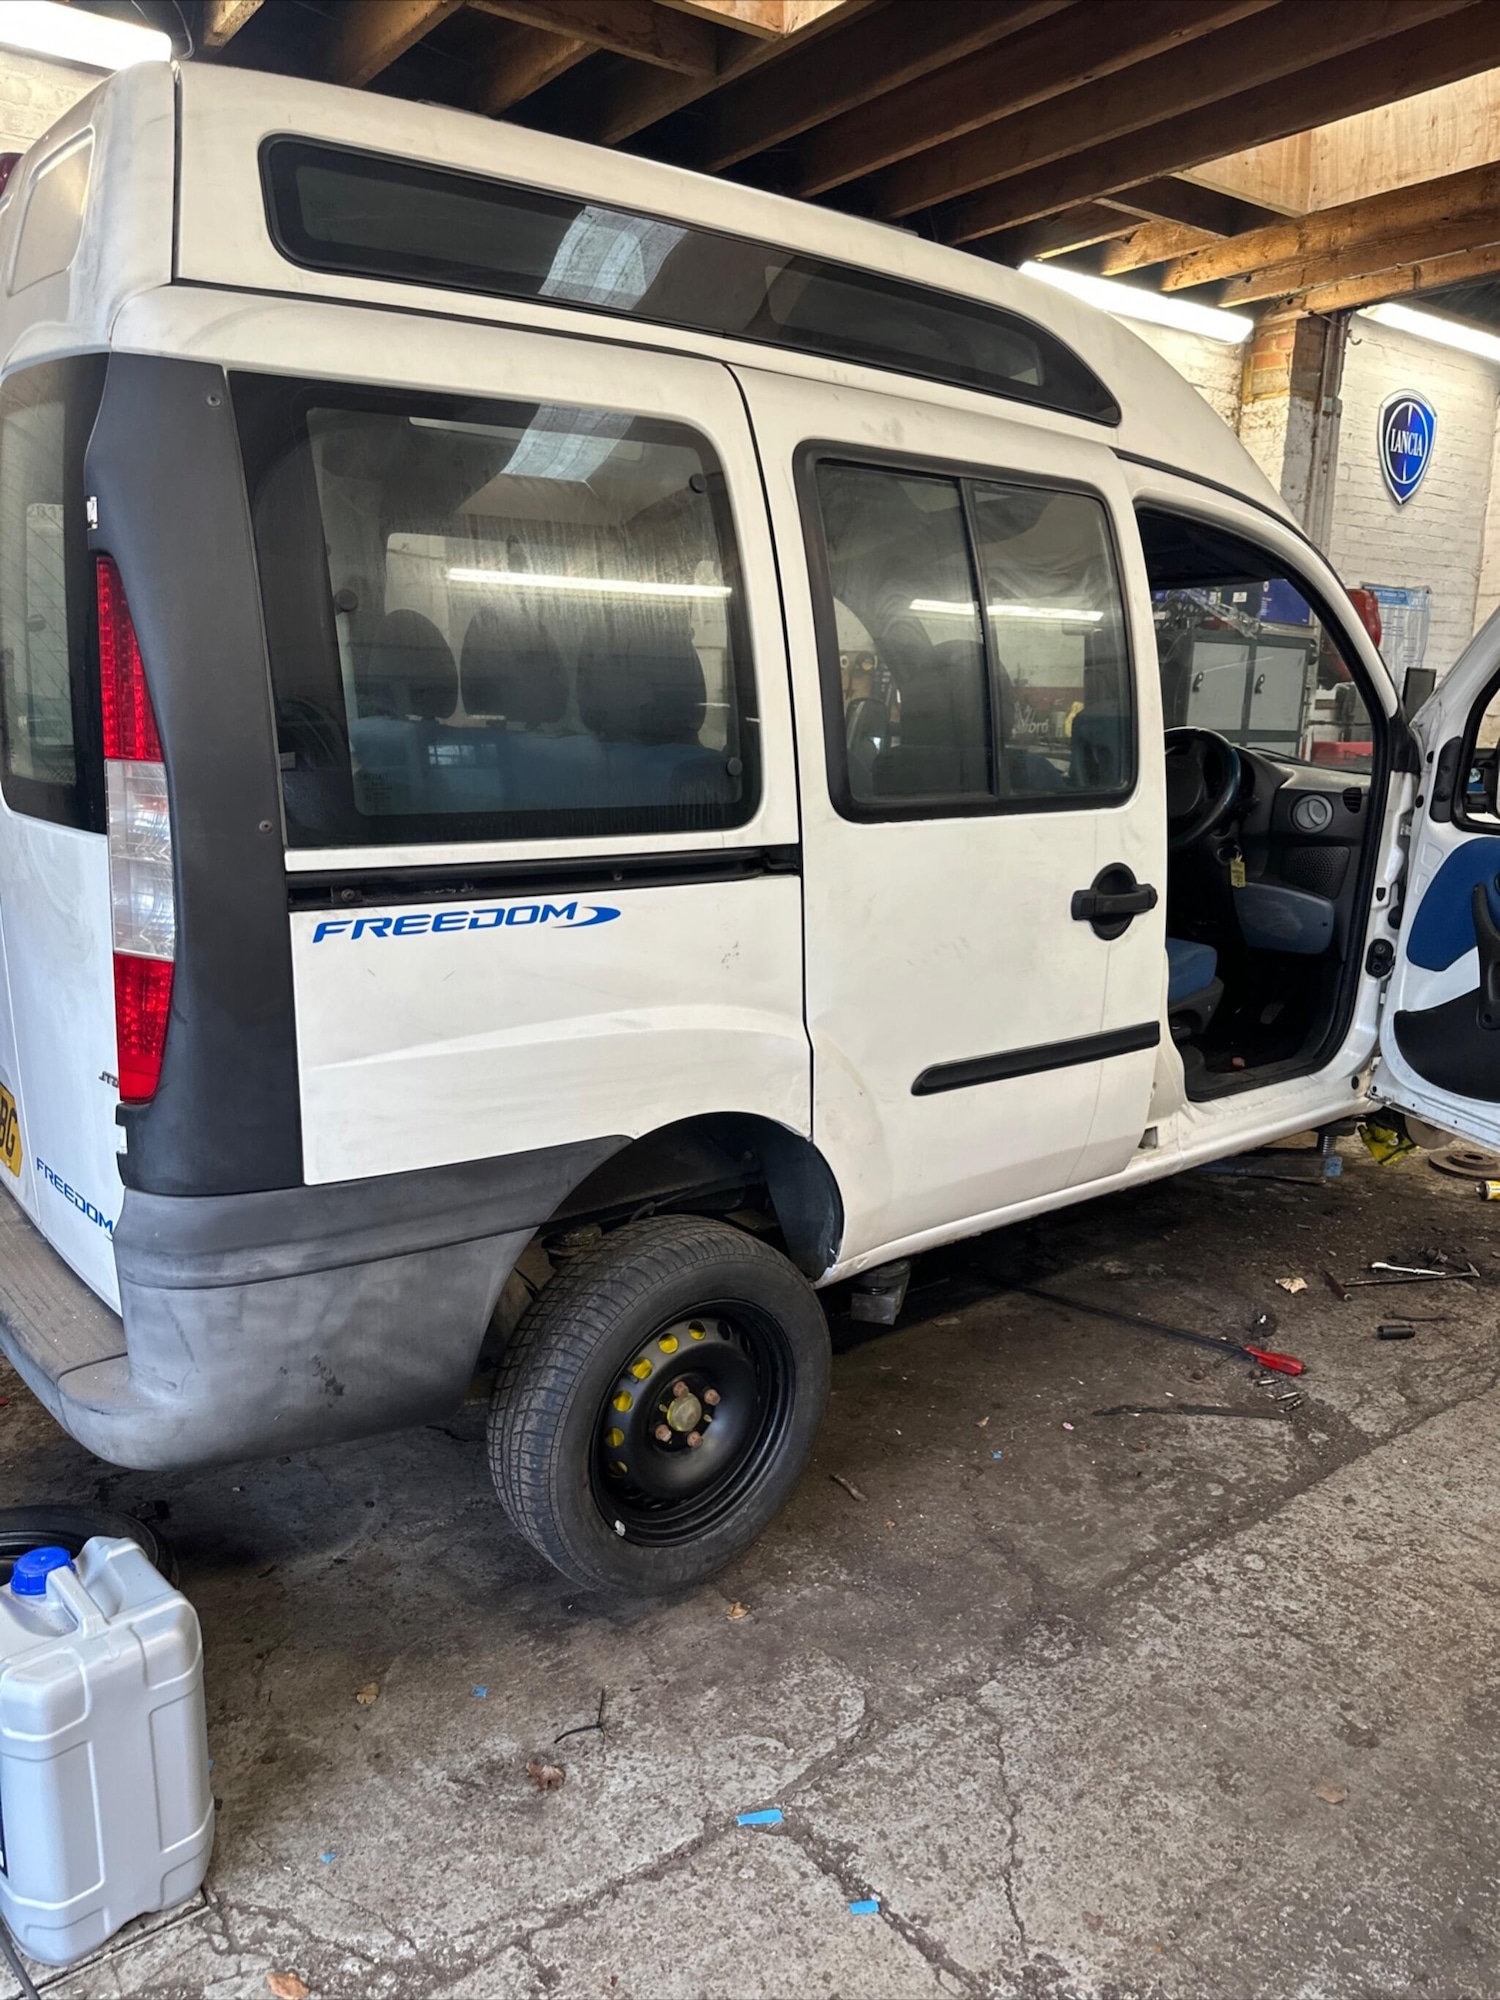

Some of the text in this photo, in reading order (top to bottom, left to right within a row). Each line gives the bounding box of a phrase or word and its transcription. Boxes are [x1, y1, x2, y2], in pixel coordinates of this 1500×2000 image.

[1390, 428, 1423, 457] LANCIA
[312, 901, 578, 943] FREEDOM
[98, 1070, 119, 1089] JTD
[36, 1157, 114, 1236] FREEDOM
